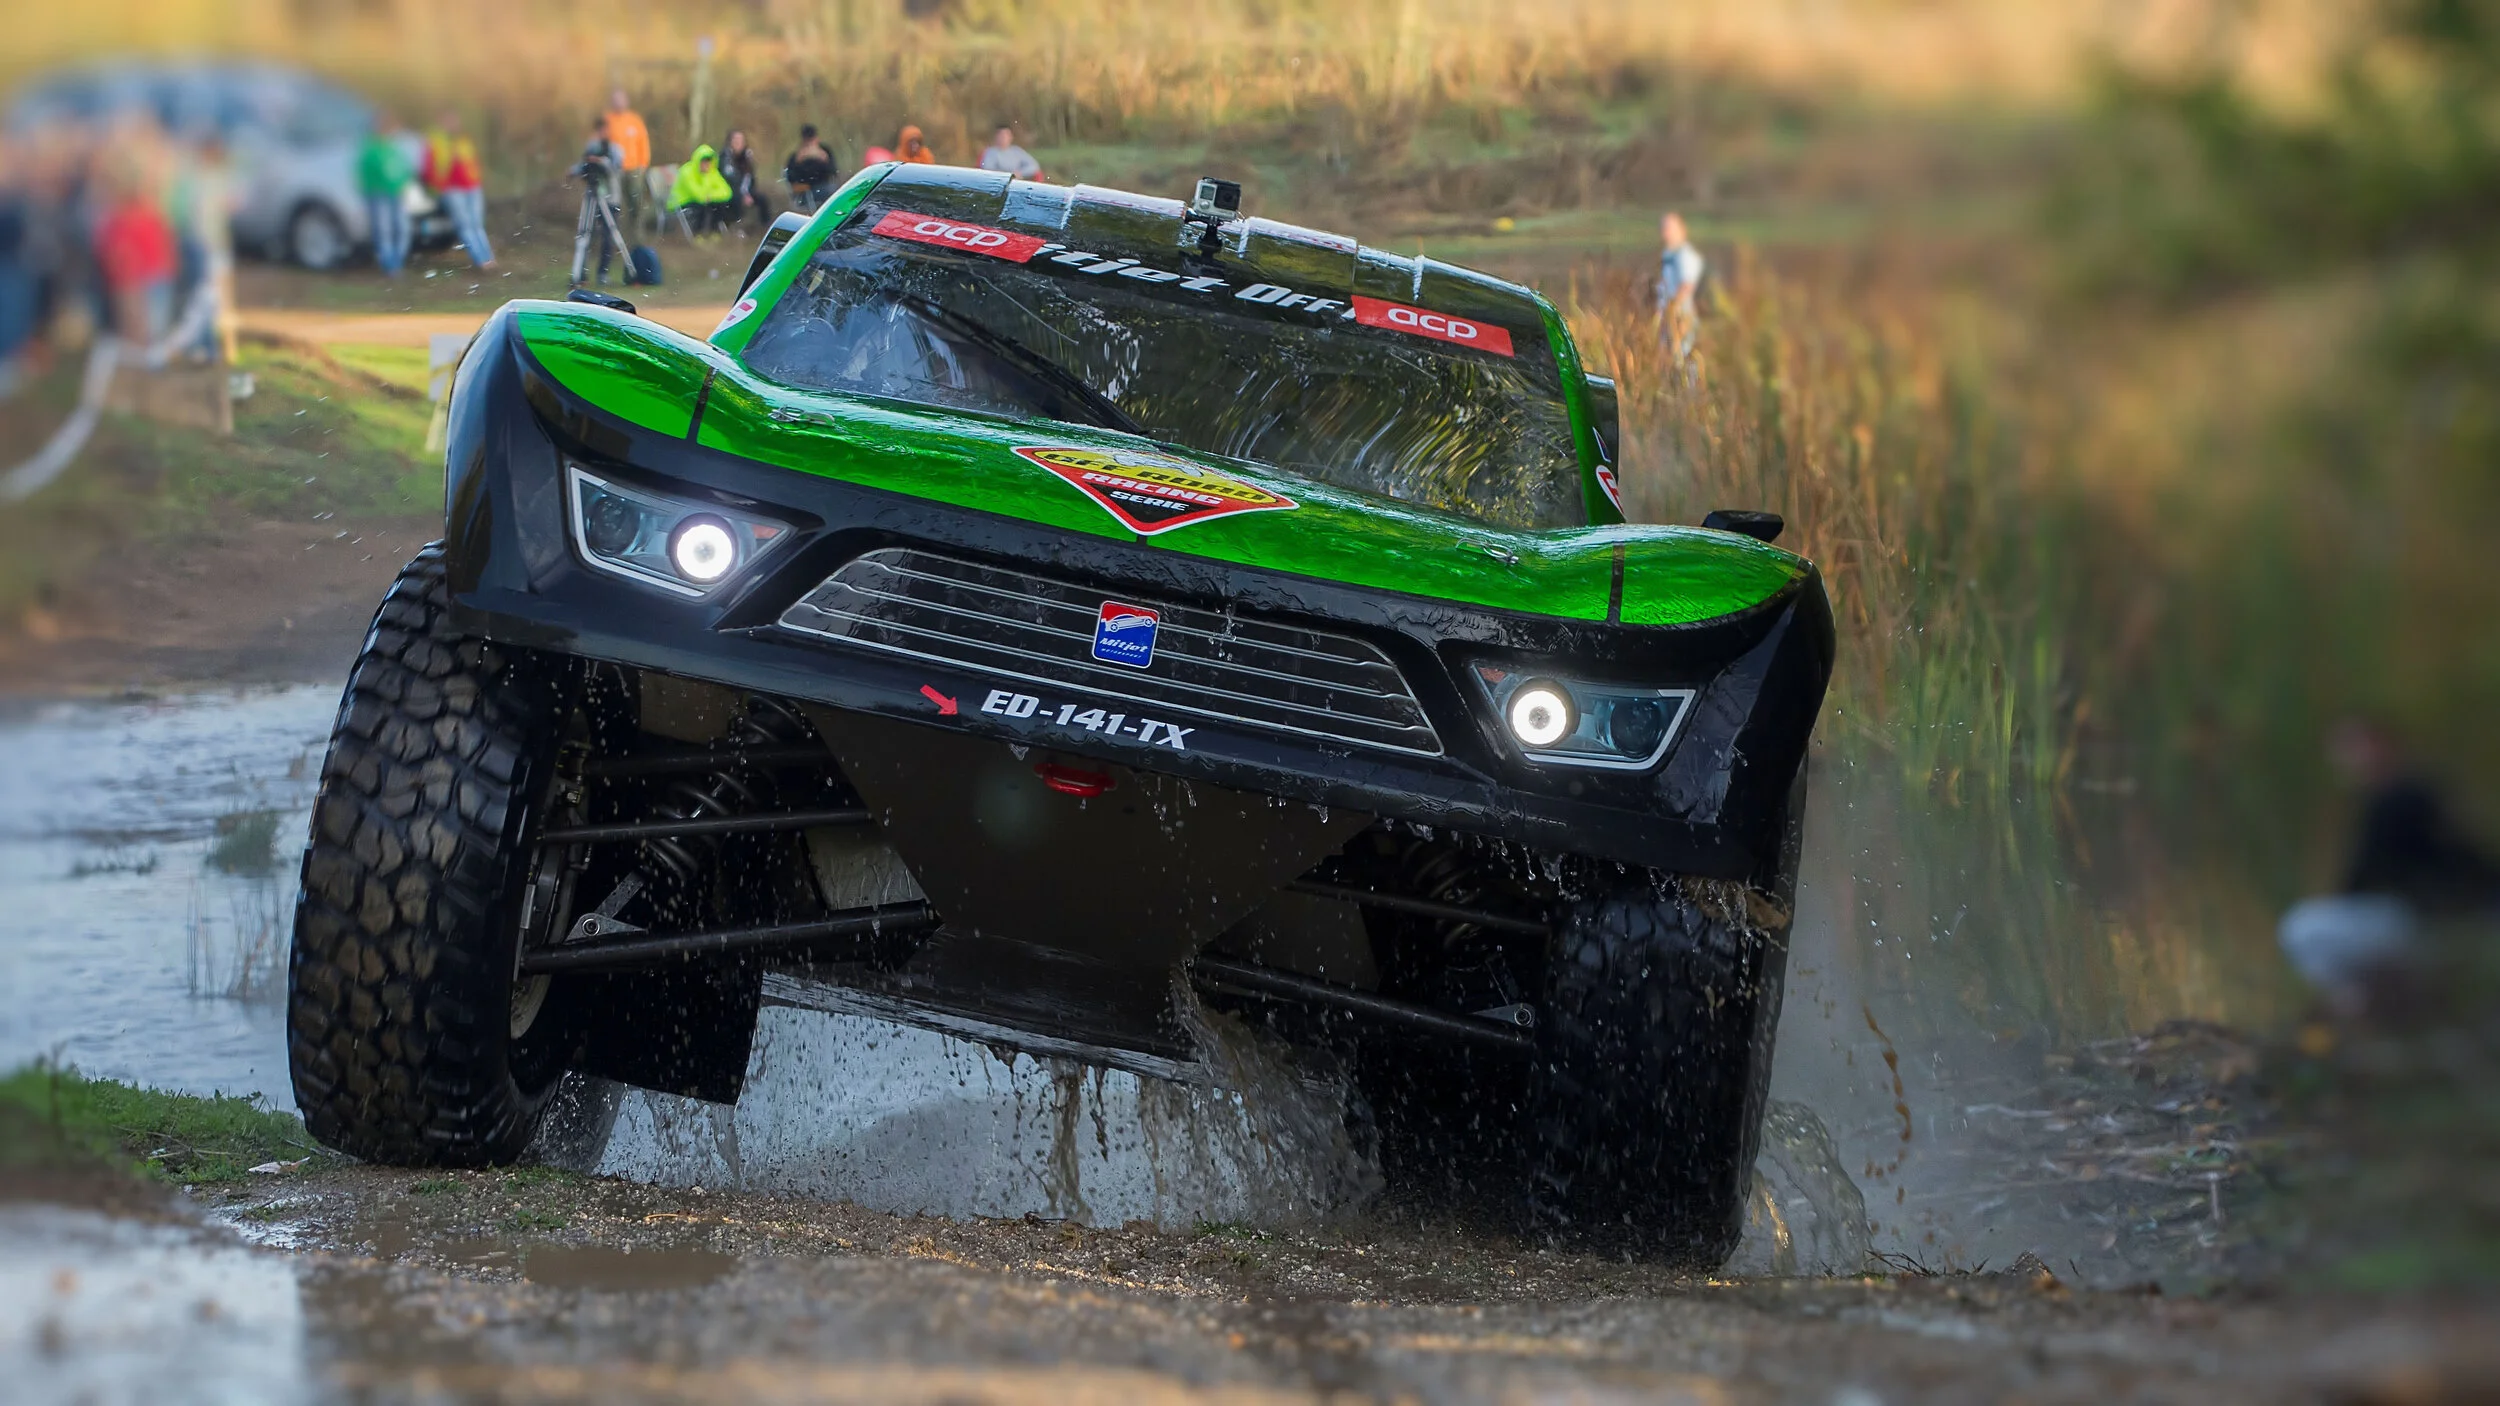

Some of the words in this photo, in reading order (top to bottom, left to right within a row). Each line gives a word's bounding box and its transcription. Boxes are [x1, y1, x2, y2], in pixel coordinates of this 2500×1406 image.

[913, 221, 1008, 247] acp
[1033, 243, 1231, 292] itjet
[1387, 308, 1478, 339] acp
[1081, 472, 1223, 505] RACING
[1136, 470, 1267, 500] ROAD
[1110, 490, 1189, 512] SERIE
[1100, 637, 1148, 653] Mitjet
[980, 689, 1195, 750] ED-141-TX
